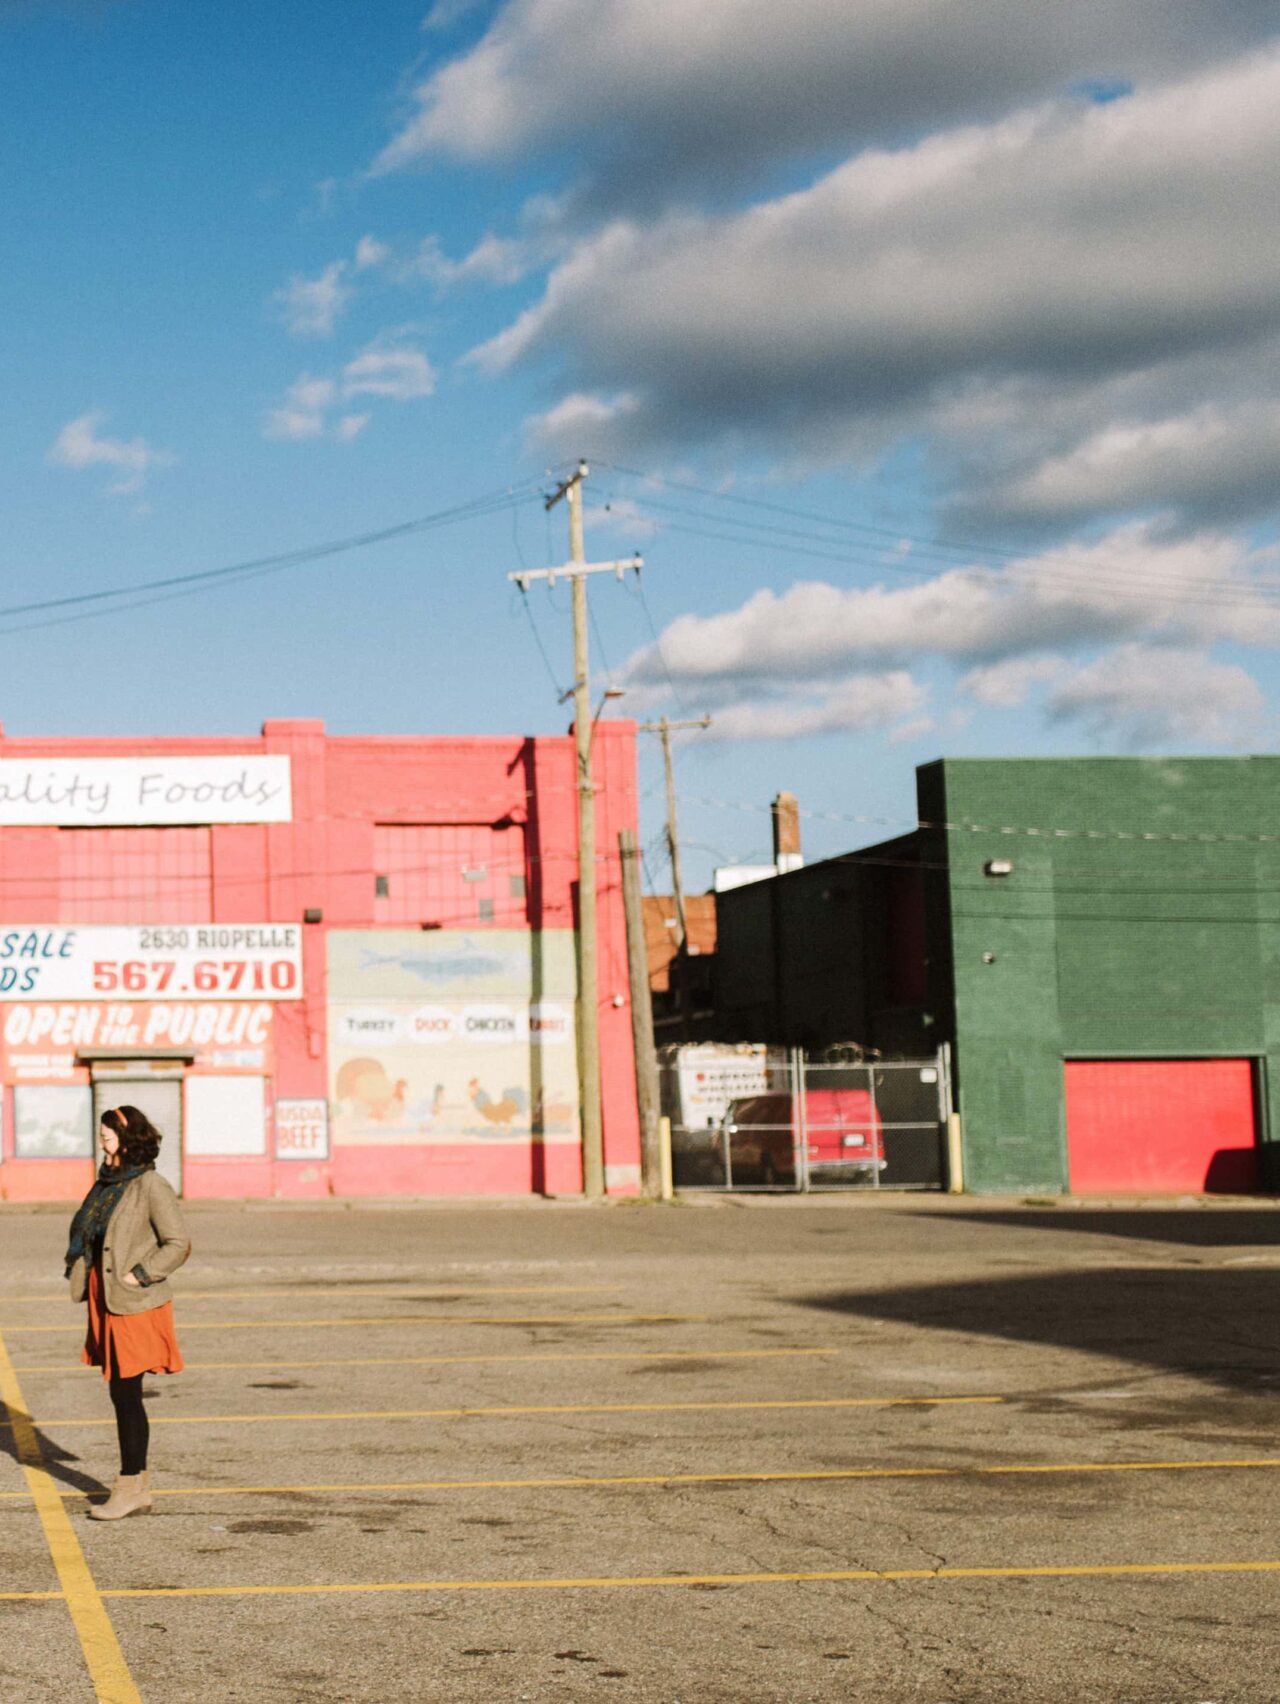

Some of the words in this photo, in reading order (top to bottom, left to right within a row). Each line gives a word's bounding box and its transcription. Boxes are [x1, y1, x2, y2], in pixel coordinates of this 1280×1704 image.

[137, 770, 283, 804] Foods
[139, 930, 189, 949] 2630
[197, 929, 297, 949] RIOPELLE
[93, 961, 297, 991] 567.6710
[4, 1005, 100, 1046] OPEN
[106, 1006, 133, 1024] TO
[143, 1003, 274, 1045] PUBLIC
[415, 1017, 451, 1032] DUCK
[100, 1026, 140, 1046] THE
[279, 1125, 321, 1149] BEEF
